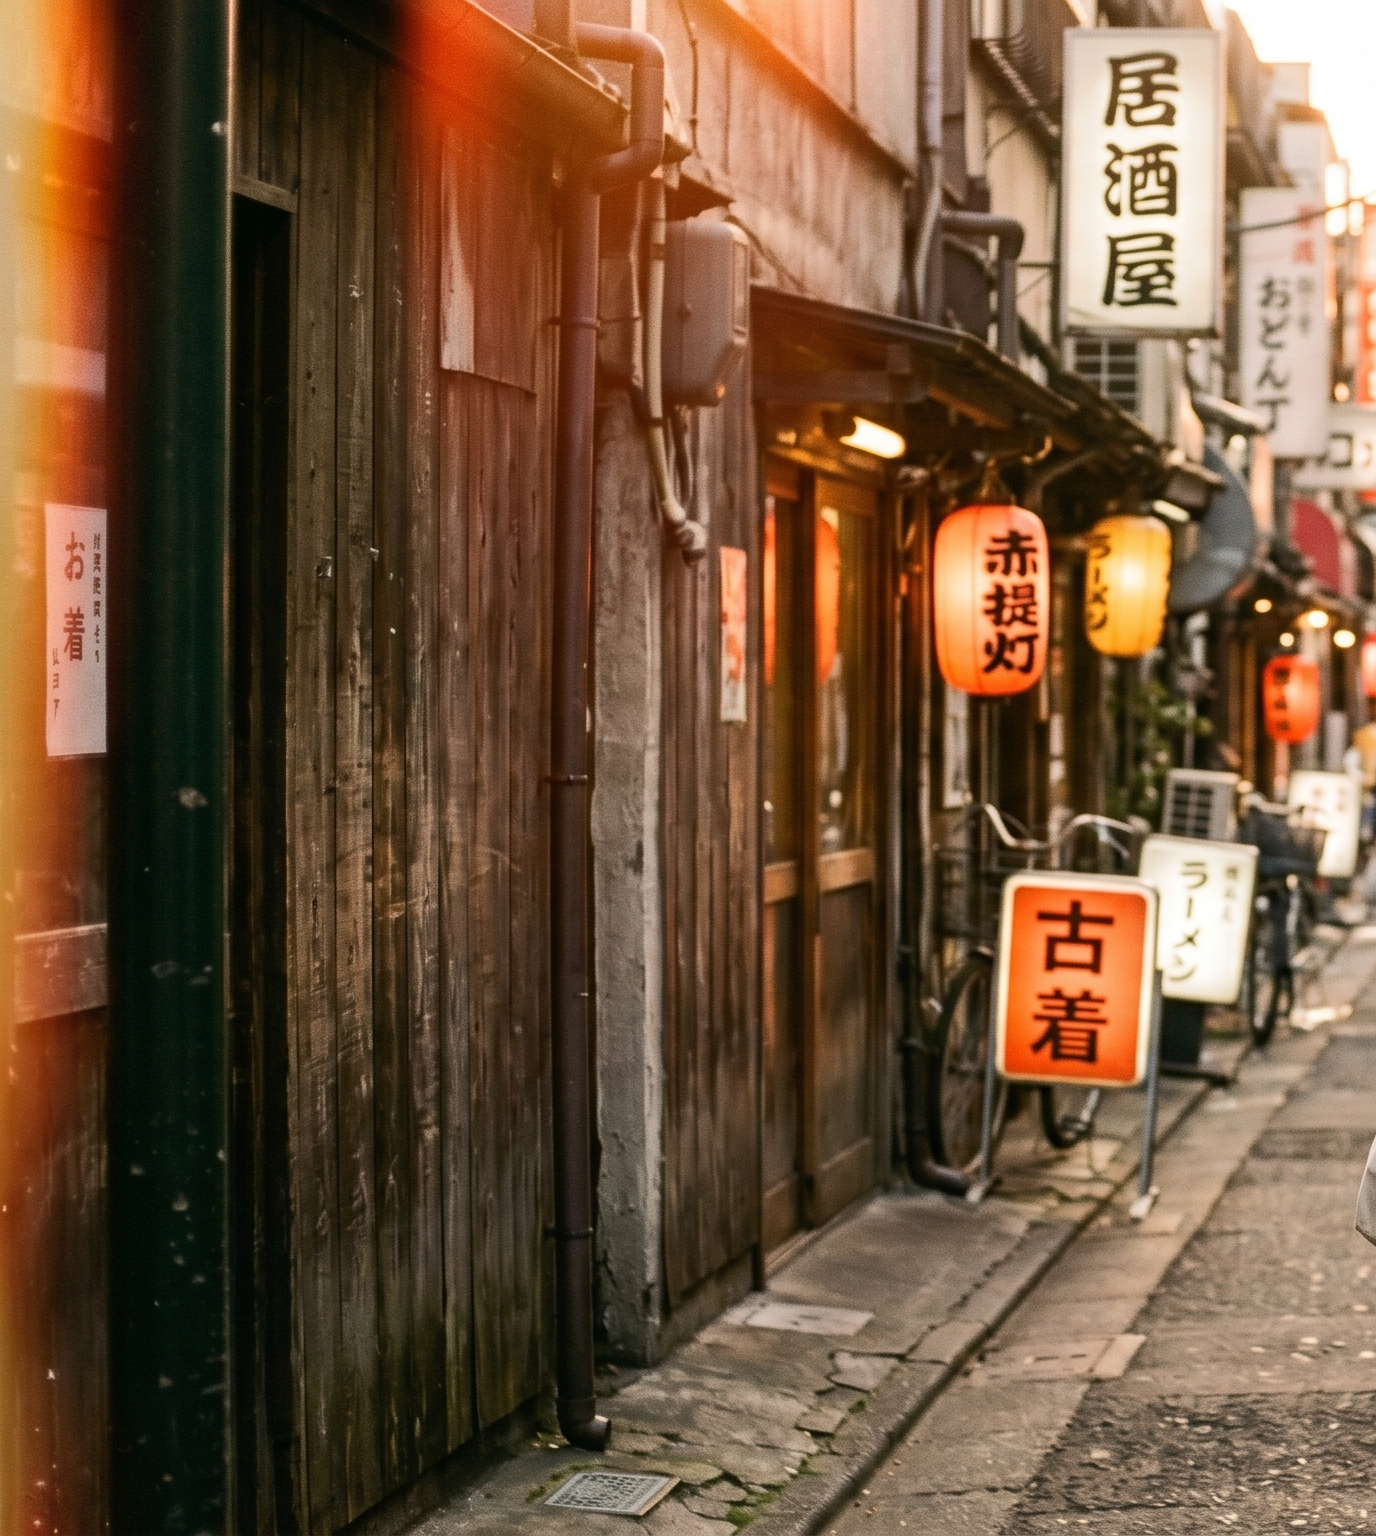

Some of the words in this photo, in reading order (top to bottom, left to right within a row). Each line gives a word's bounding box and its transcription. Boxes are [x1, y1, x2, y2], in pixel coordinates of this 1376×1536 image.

[1103, 51, 1180, 307] 居酒屋
[63, 531, 85, 661] お着
[983, 530, 1039, 674] 赤提灯
[1031, 901, 1114, 1064] 古着
[1169, 862, 1207, 983] ラーメン
